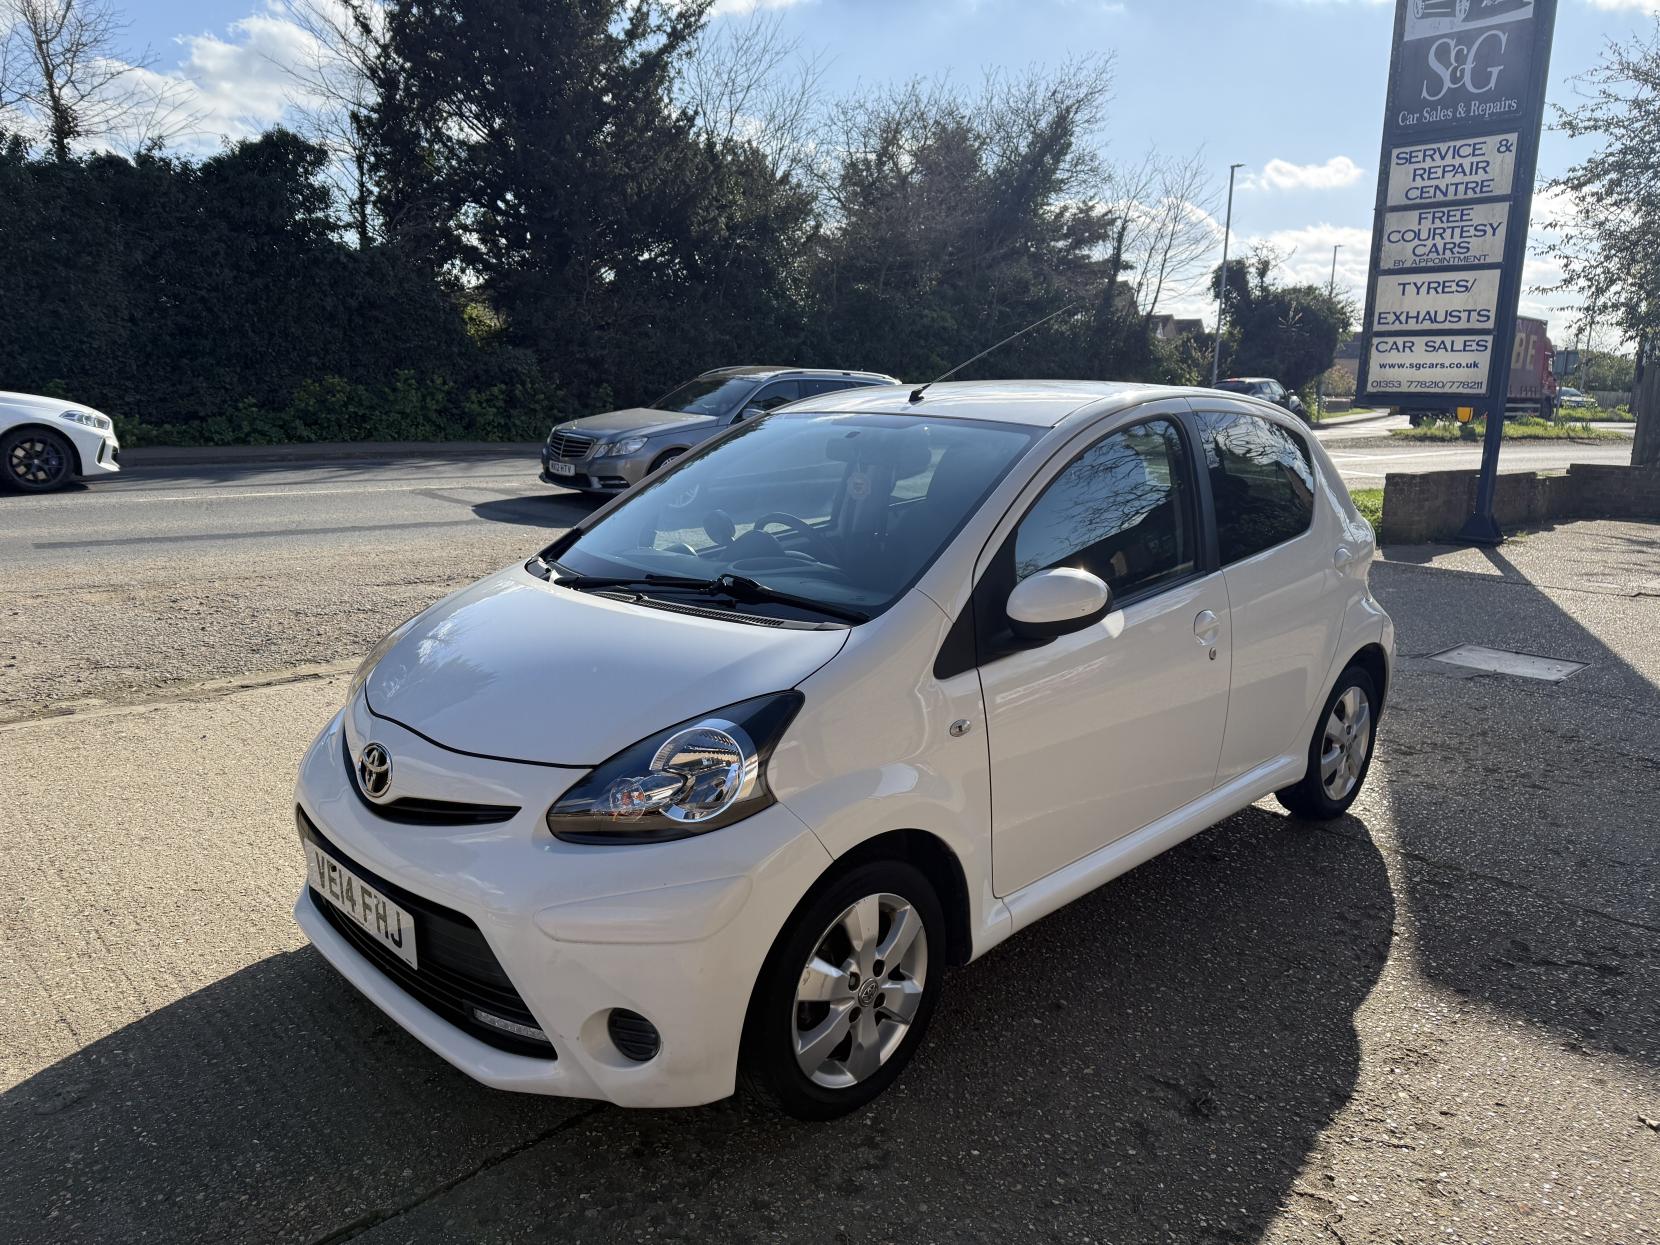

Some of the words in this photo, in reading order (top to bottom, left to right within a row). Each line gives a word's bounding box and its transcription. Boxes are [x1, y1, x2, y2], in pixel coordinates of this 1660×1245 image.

[1421, 29, 1509, 100] S&G
[1398, 110, 1418, 126] Car
[1422, 106, 1453, 123] Sales
[1456, 105, 1467, 118] &
[1469, 97, 1517, 118] Repairs
[1395, 141, 1487, 166] SERVICE
[1496, 138, 1513, 155] &
[1412, 160, 1490, 183] REPAIR
[1405, 179, 1494, 201] CENTRE
[1417, 207, 1474, 226] FREE
[1387, 222, 1503, 244] COURTESY
[1411, 240, 1472, 258] CARS
[1393, 258, 1407, 267] BY
[1410, 254, 1488, 266] APPOINTMENT
[1397, 278, 1477, 297] TYRES/
[1376, 308, 1491, 326] EXHAUSTS
[1375, 341, 1415, 353] CAR
[1424, 339, 1489, 353] SALES
[1379, 361, 1480, 371] www.sgcars.co.uk
[1371, 380, 1402, 389] 01353
[1406, 380, 1483, 390] 778210/778211
[315, 850, 356, 914] VE14
[360, 884, 403, 949] FHJ
